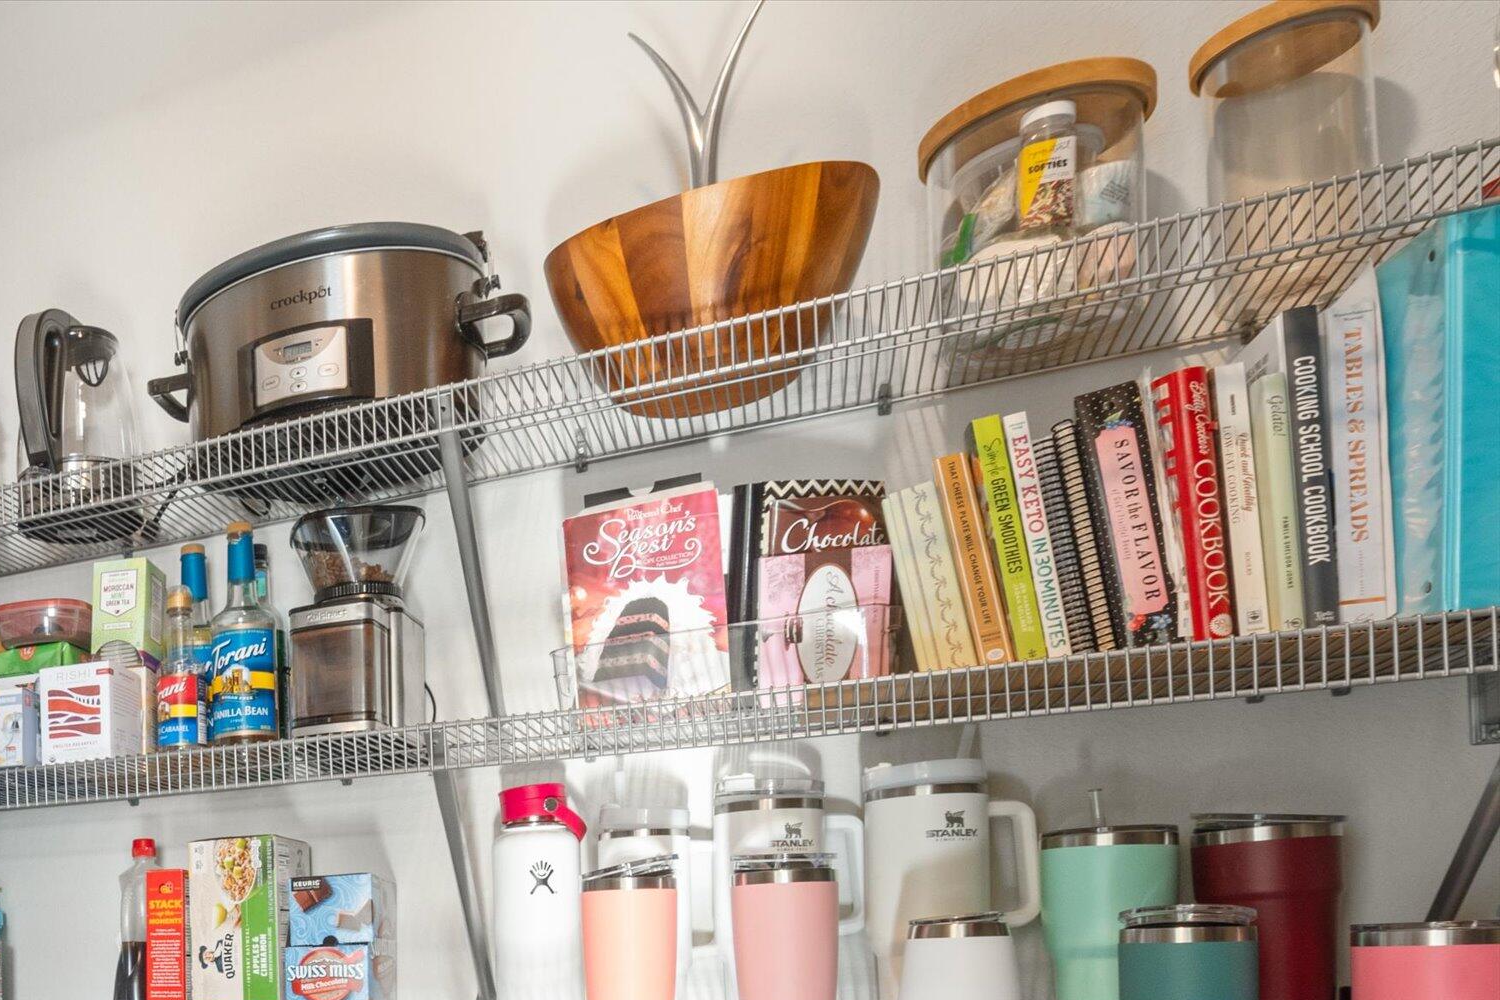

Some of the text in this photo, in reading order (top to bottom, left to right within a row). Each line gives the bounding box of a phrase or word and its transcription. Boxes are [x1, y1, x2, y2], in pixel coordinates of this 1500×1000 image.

[1028, 158, 1068, 175] SOFTIES
[270, 285, 332, 312] crockpot
[1342, 326, 1369, 544] TABLES SPREADS
[1114, 438, 1139, 498] SAVOR
[1293, 355, 1331, 567] COOKING SCHOOL COOKBOOK
[990, 478, 1023, 574] GREEN SMOOTHIES
[1127, 500, 1139, 520] the
[583, 510, 697, 565] Season's
[781, 518, 886, 554] Chocolate
[948, 461, 992, 625] THAT CHEESE PLATE WILL CHANGE YOUR LIFE
[1012, 434, 1066, 649] EASY KETO IN 30 MINUTES
[1193, 459, 1230, 609] COOKBOOK
[610, 534, 676, 578] Best
[1132, 523, 1161, 600] FLAVOR
[103, 583, 134, 593] MOROCCAN
[56, 668, 91, 682] RISHI
[211, 637, 267, 680] Torani
[244, 705, 269, 717] BEAN
[768, 838, 814, 849] STANLEY
[926, 828, 979, 839] STANLEY
[292, 878, 321, 888] KEURIG
[148, 899, 183, 909] STACK
[224, 932, 237, 980] QUAKER
[252, 942, 260, 975] APPLES
[259, 933, 268, 977] CINNAMON
[287, 962, 365, 982] SWISS MISS
